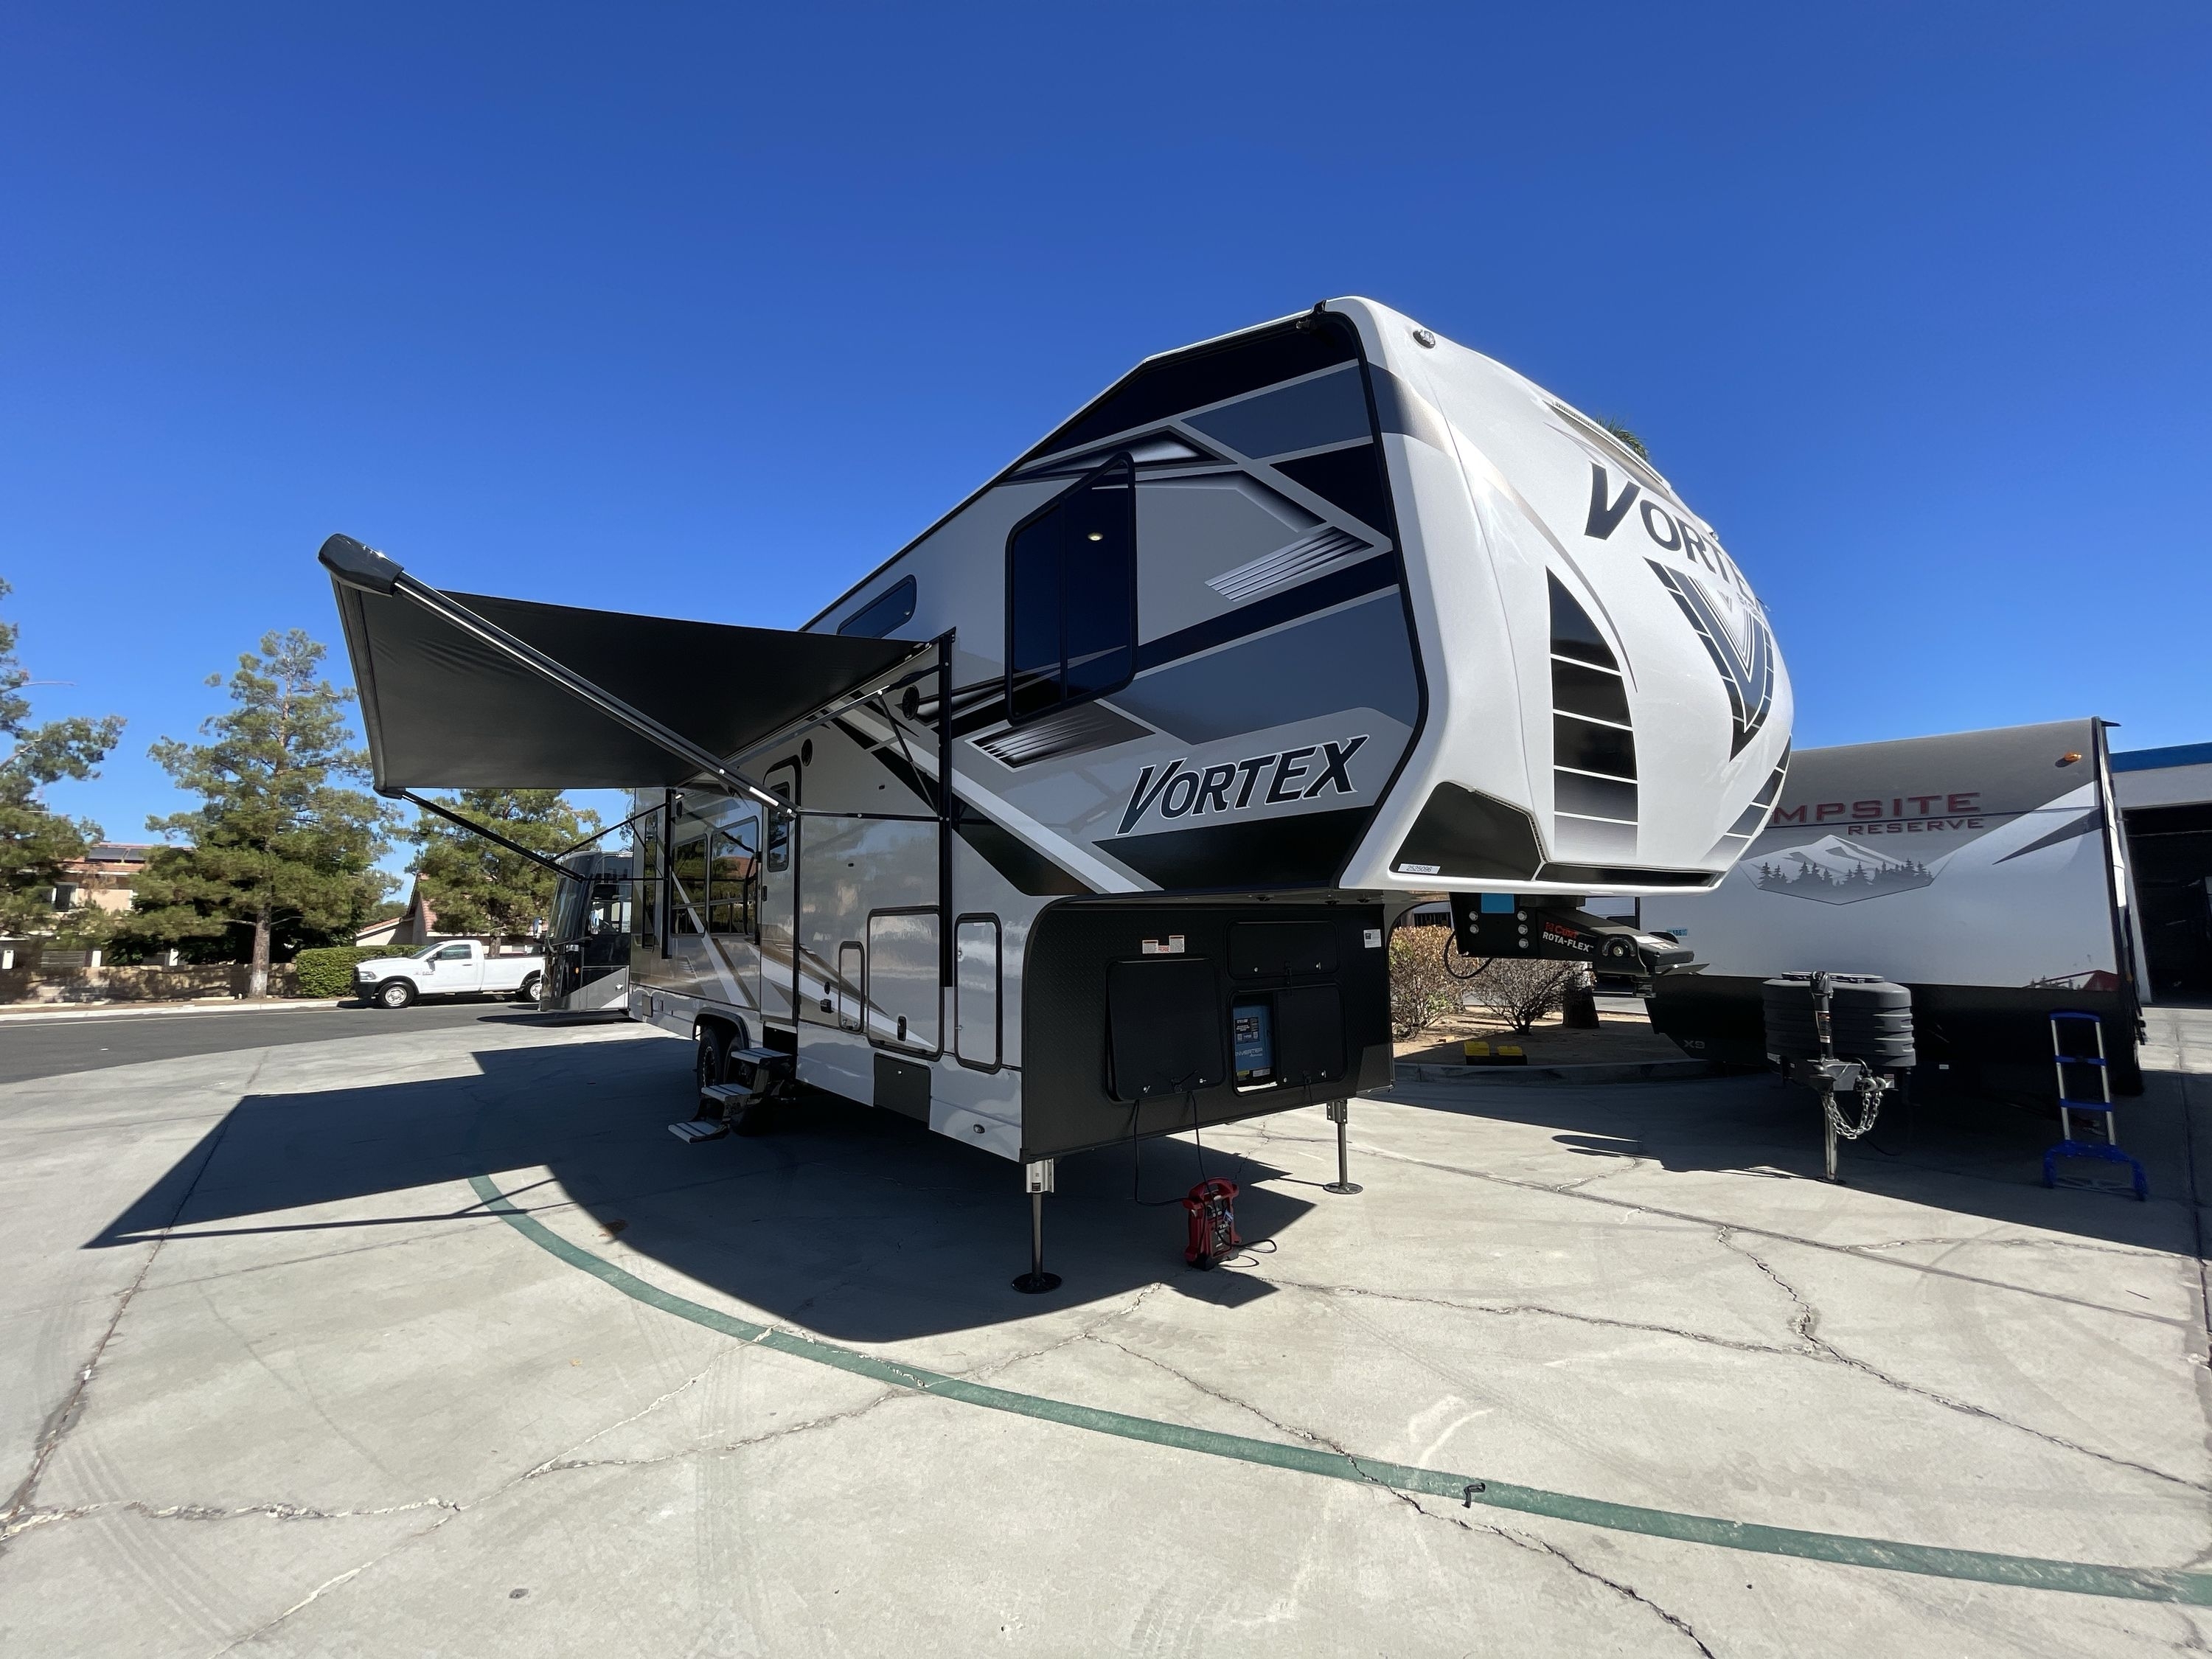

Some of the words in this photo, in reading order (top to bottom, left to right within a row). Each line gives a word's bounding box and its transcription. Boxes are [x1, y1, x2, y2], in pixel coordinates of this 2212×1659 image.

[1584, 460, 1761, 614] VORTE
[1115, 734, 1370, 836] VORTEX
[1773, 792, 1981, 824] MPSITE
[1848, 818, 1984, 835] RESERVE
